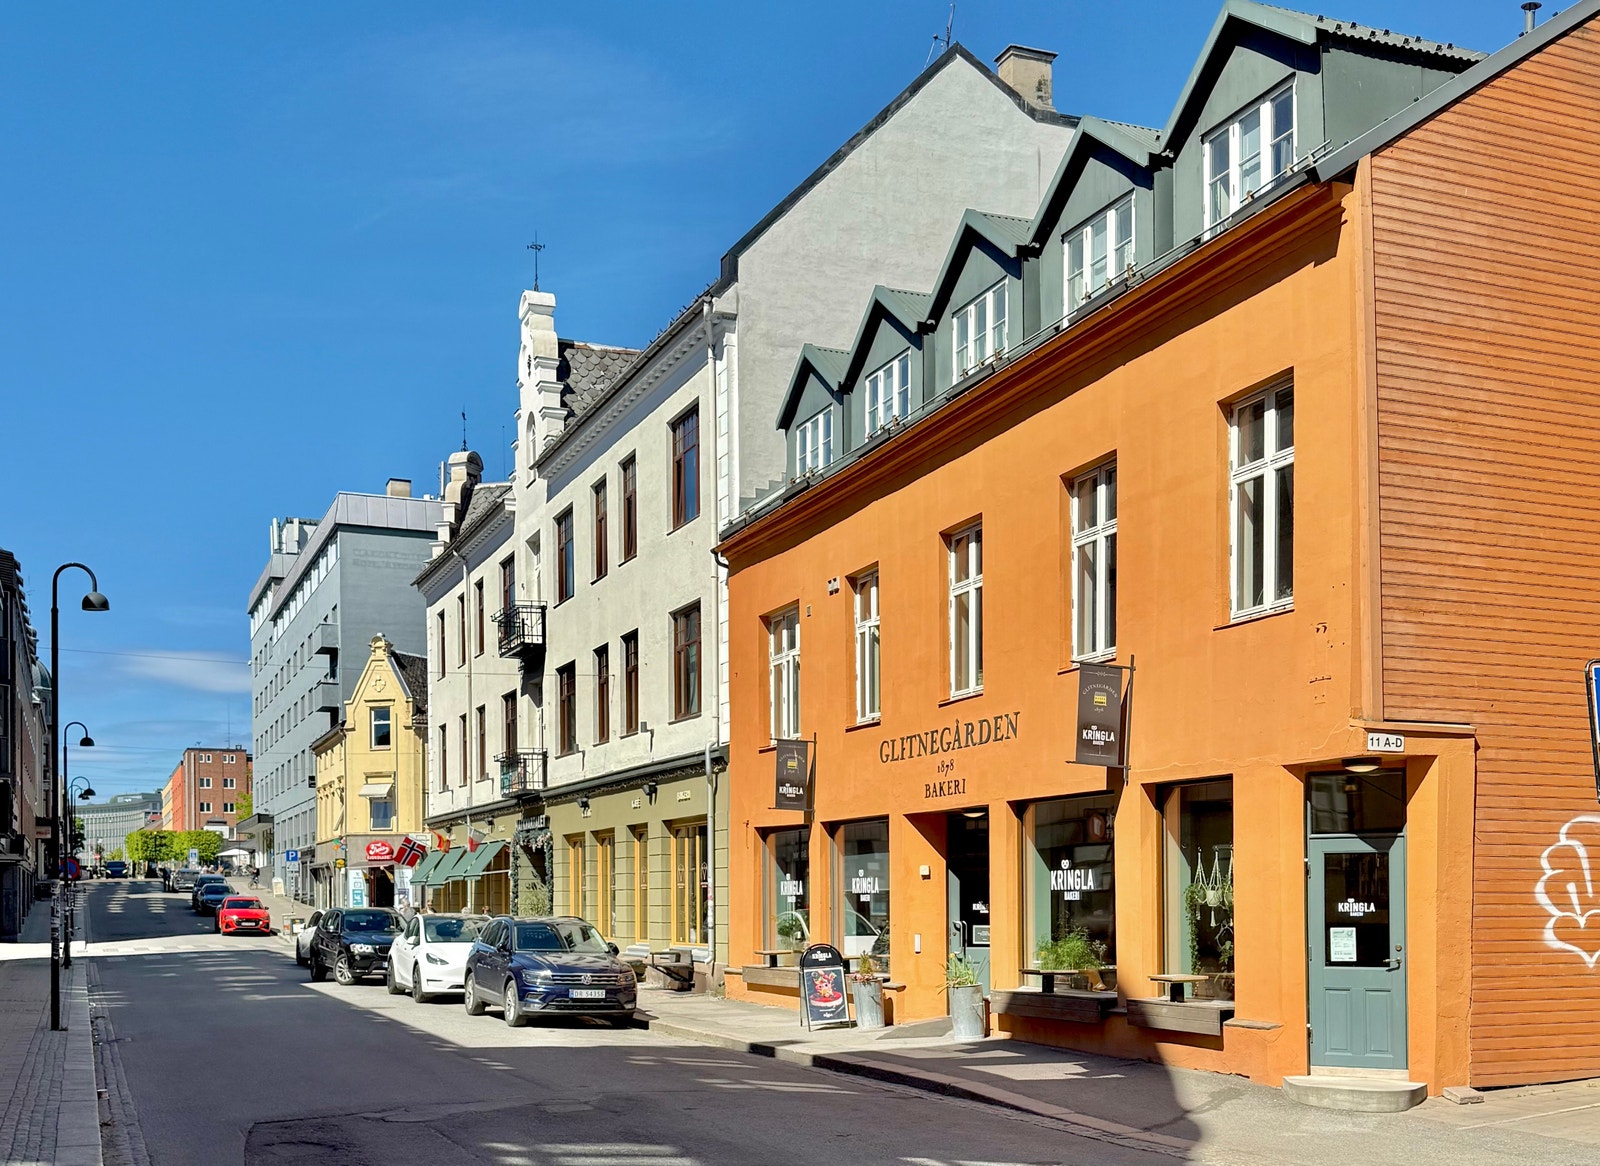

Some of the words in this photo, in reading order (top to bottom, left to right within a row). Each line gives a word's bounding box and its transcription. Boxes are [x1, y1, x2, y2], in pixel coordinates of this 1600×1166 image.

[879, 711, 1021, 764] GLITNEGÅRDEN
[1082, 728, 1115, 742] KRINGLA
[1369, 736, 1380, 747] 11
[1383, 736, 1403, 748] A-D
[937, 758, 955, 777] 1878
[778, 785, 804, 796] KRINGLA
[924, 778, 966, 799] BAKERI
[288, 851, 296, 861] P
[851, 876, 880, 894] KRINGLA
[1050, 868, 1095, 891] KRINGLA
[780, 880, 804, 896] KRINGLA
[1337, 902, 1376, 913] KRINGLA
